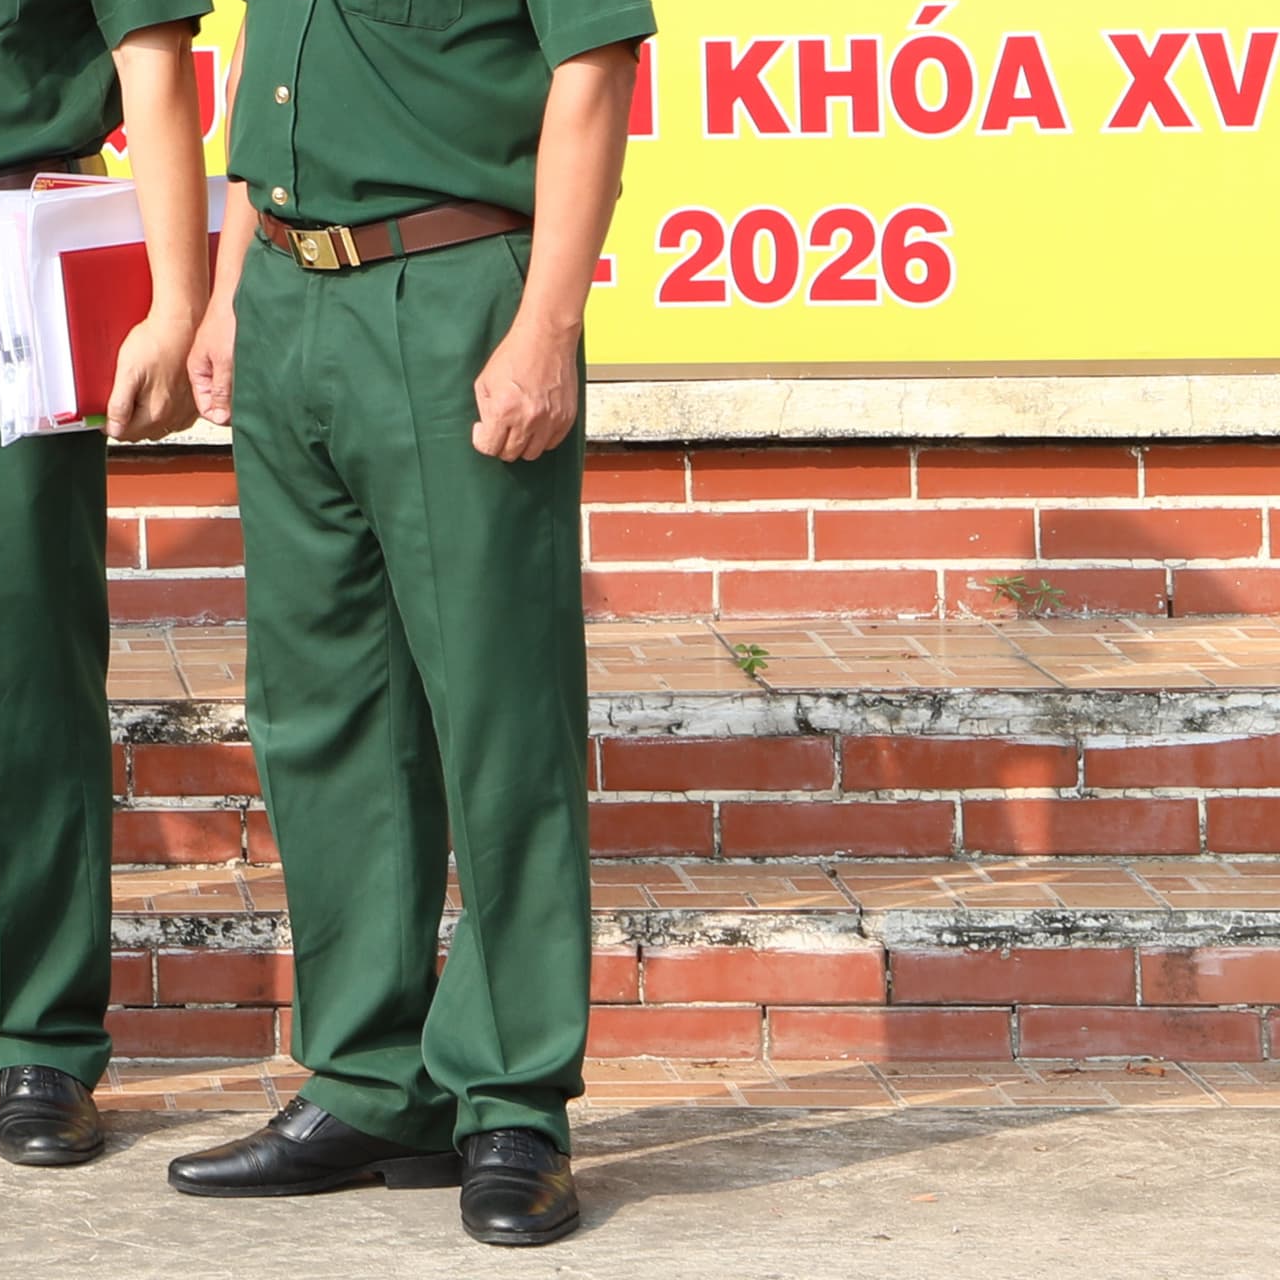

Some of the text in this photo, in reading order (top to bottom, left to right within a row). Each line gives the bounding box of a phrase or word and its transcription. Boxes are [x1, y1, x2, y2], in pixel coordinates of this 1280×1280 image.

[705, 5, 1066, 134] KHÓA
[1108, 32, 1279, 128] XV
[659, 207, 951, 303] 2026
